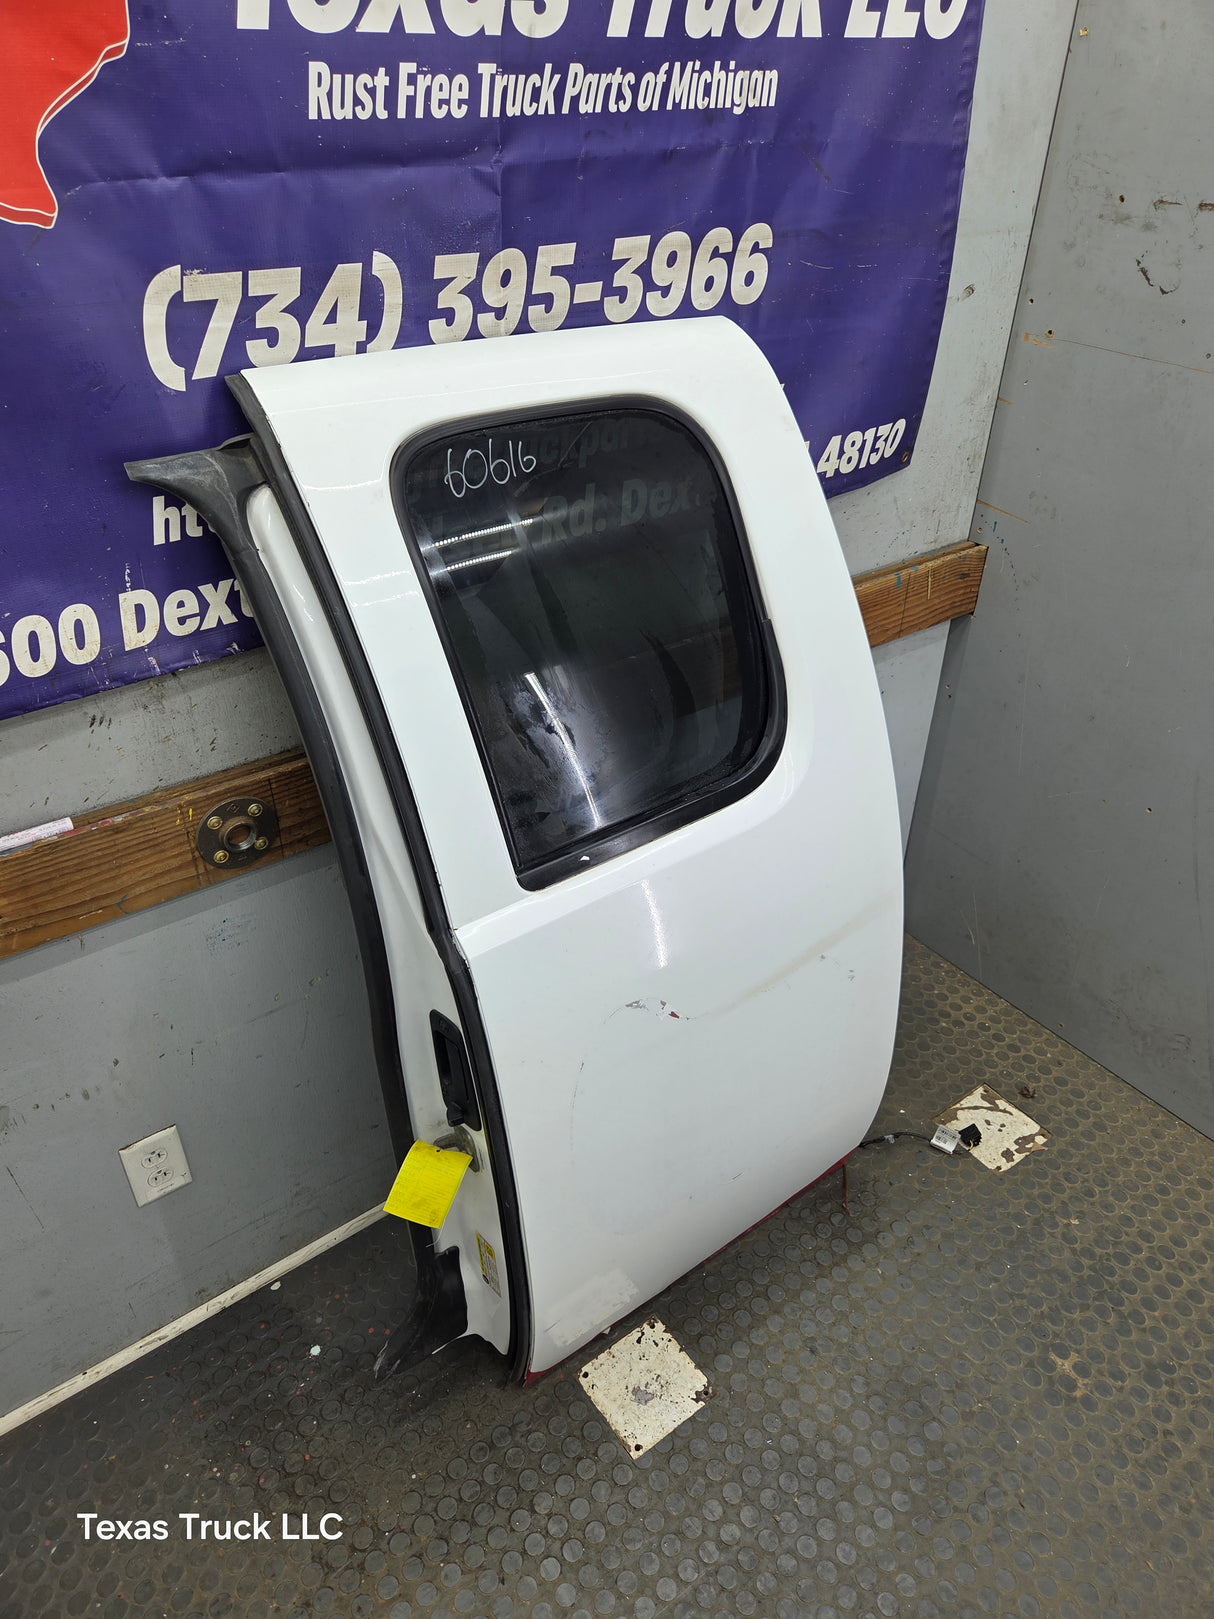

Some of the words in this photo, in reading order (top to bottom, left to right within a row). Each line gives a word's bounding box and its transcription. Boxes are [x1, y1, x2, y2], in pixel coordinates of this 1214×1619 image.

[308, 61, 390, 120] Rust
[398, 63, 469, 119] Free
[478, 64, 561, 118] Truck
[562, 63, 635, 114] Parts
[638, 60, 668, 112] of
[669, 60, 779, 115] Michigan
[143, 250, 403, 392] (734)
[428, 222, 774, 344] 395-3966
[444, 438, 537, 498] 60616
[0, 603, 101, 687] 00
[816, 418, 907, 479] 48130
